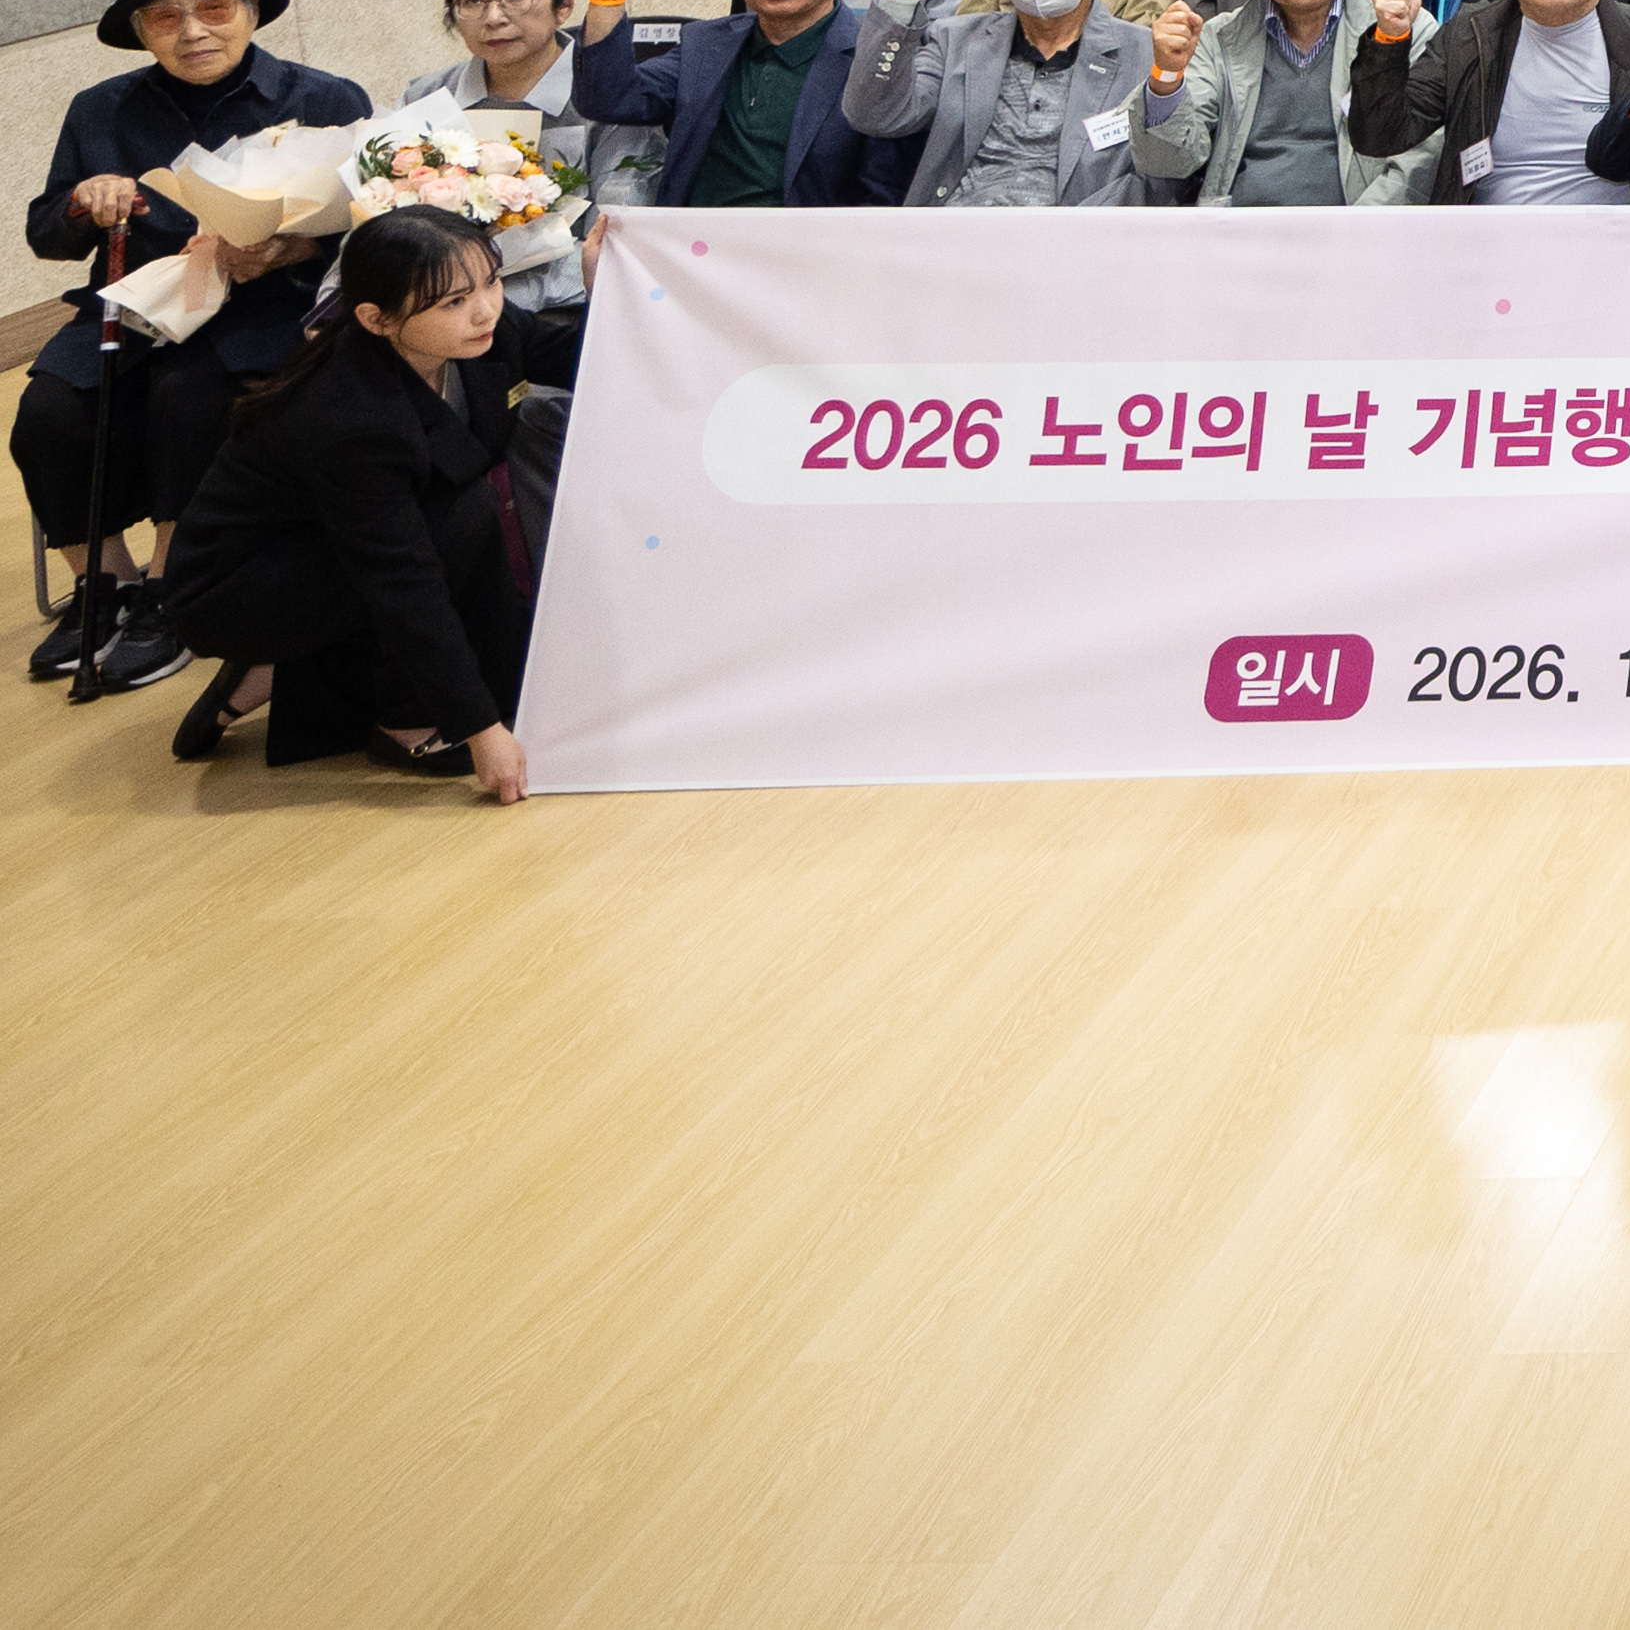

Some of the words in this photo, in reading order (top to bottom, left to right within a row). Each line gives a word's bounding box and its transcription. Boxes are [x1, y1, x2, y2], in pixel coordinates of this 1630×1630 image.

[803, 400, 1001, 469] 2026
[1030, 392, 1266, 470] 노인의
[1305, 392, 1378, 469] 날
[1237, 649, 1340, 706] 일시
[1408, 644, 1579, 702] 2026.
